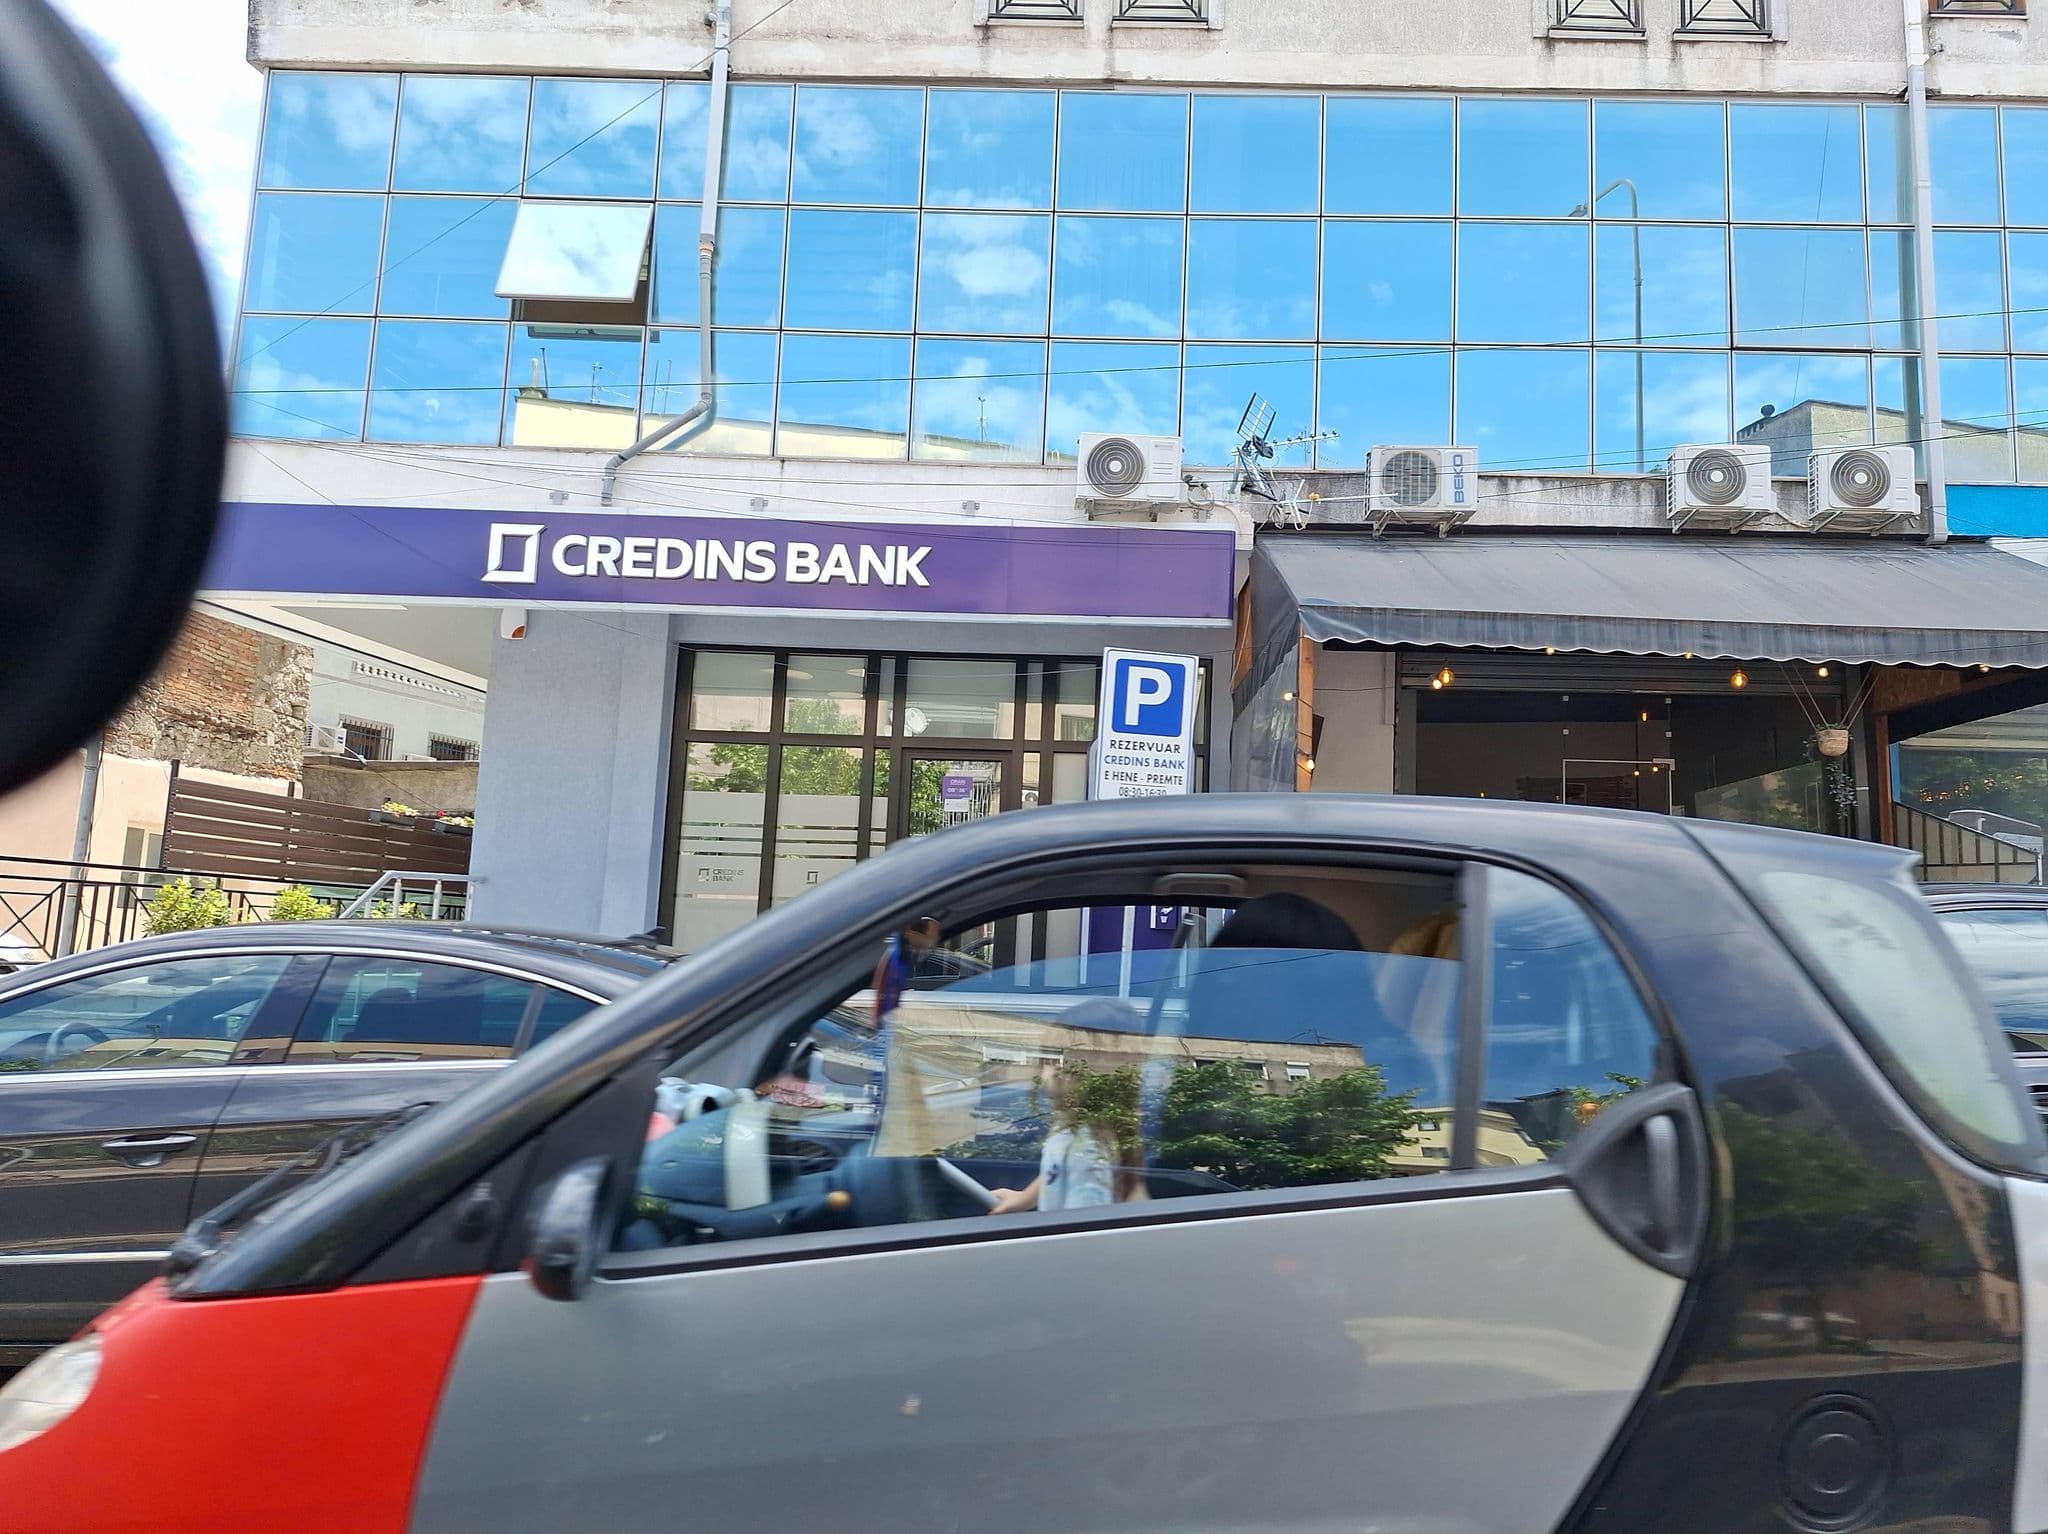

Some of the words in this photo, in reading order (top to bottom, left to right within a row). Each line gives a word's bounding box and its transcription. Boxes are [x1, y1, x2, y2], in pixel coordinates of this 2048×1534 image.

[1453, 454, 1464, 503] BEKO
[551, 534, 777, 583] CREDINS
[785, 541, 933, 587] BANK
[1125, 665, 1172, 726] P
[1109, 739, 1181, 753] REZERVUAR
[1104, 755, 1150, 767] CREDINS
[1153, 758, 1185, 770] BANK
[1104, 770, 1110, 780] E
[1112, 771, 1138, 782] HENE
[1146, 773, 1183, 785] PREMTE
